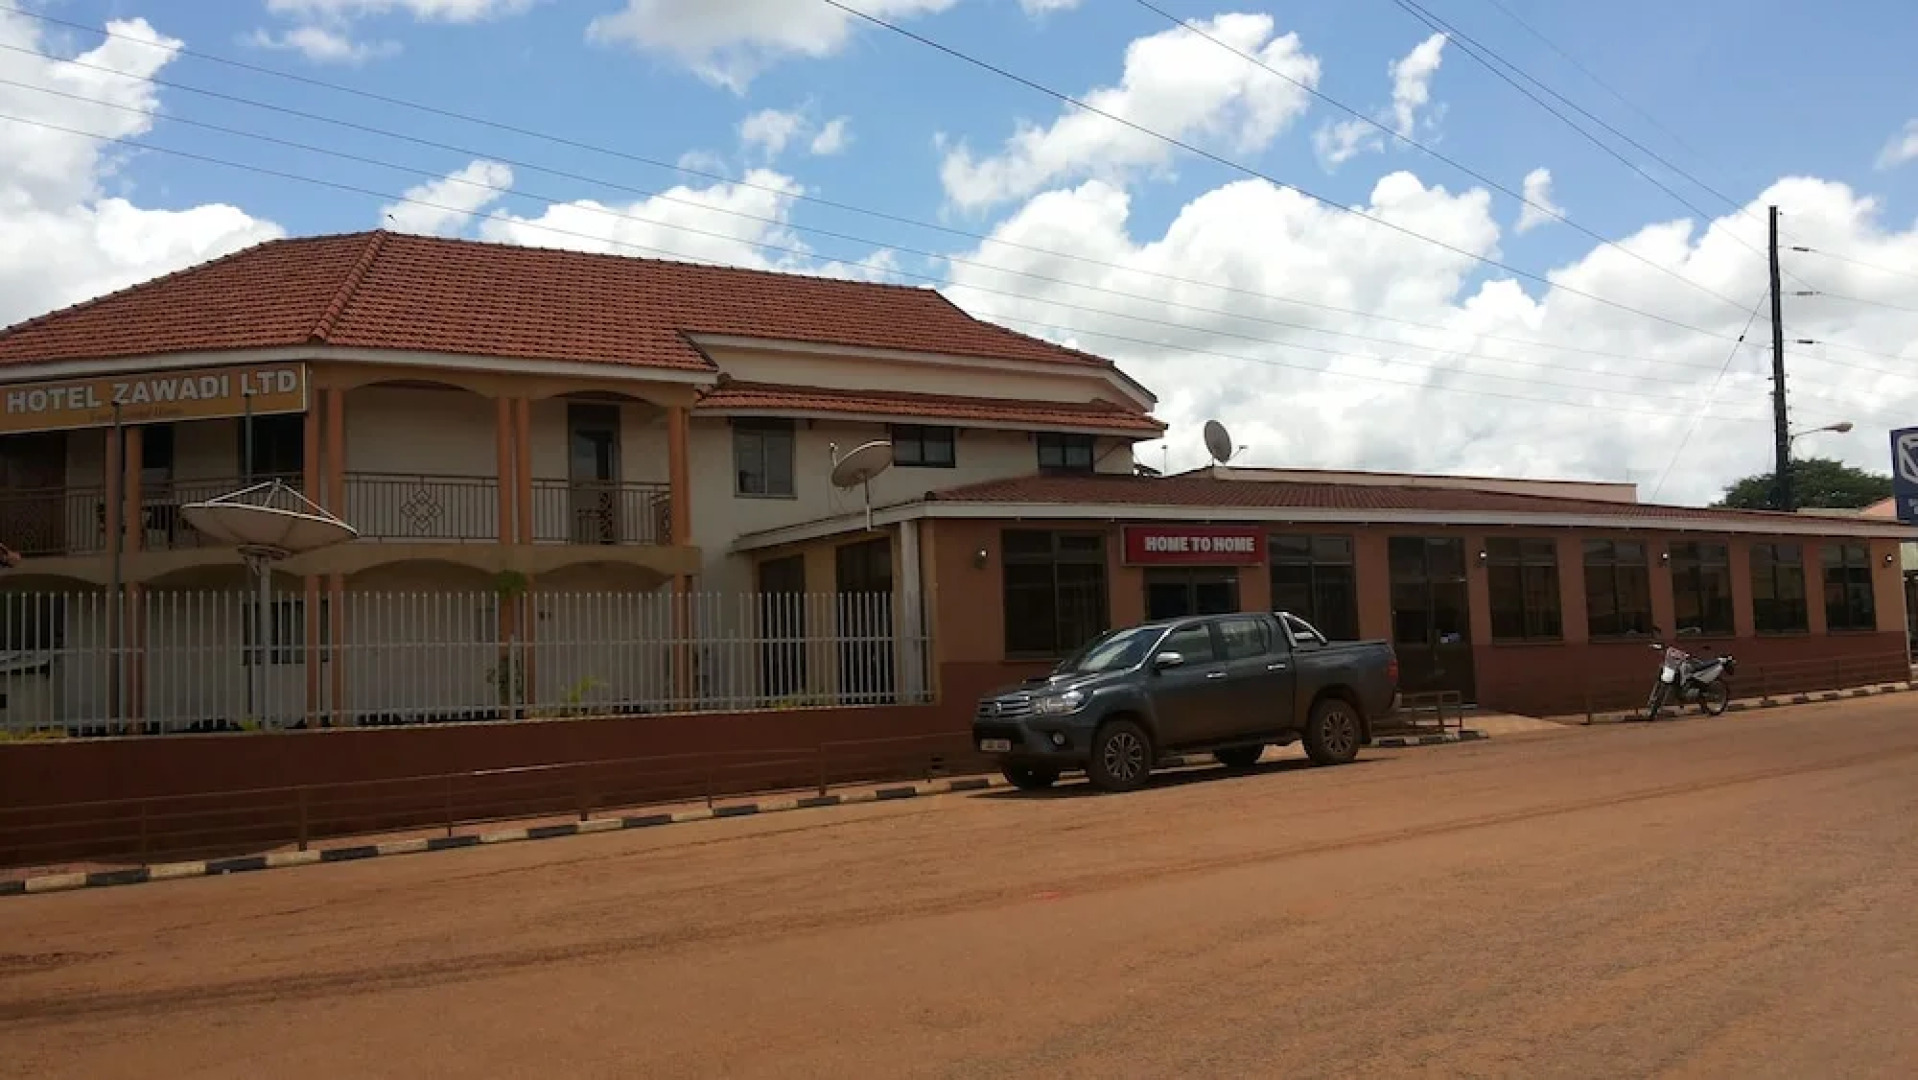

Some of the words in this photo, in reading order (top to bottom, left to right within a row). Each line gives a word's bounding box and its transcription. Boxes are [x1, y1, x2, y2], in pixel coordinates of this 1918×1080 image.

[7, 386, 102, 414] HOTEL
[113, 375, 230, 404] ZAWADI
[241, 370, 298, 395] LTD
[1144, 536, 1188, 552] HOME
[1190, 536, 1211, 552] TO
[1213, 536, 1255, 552] HOME
